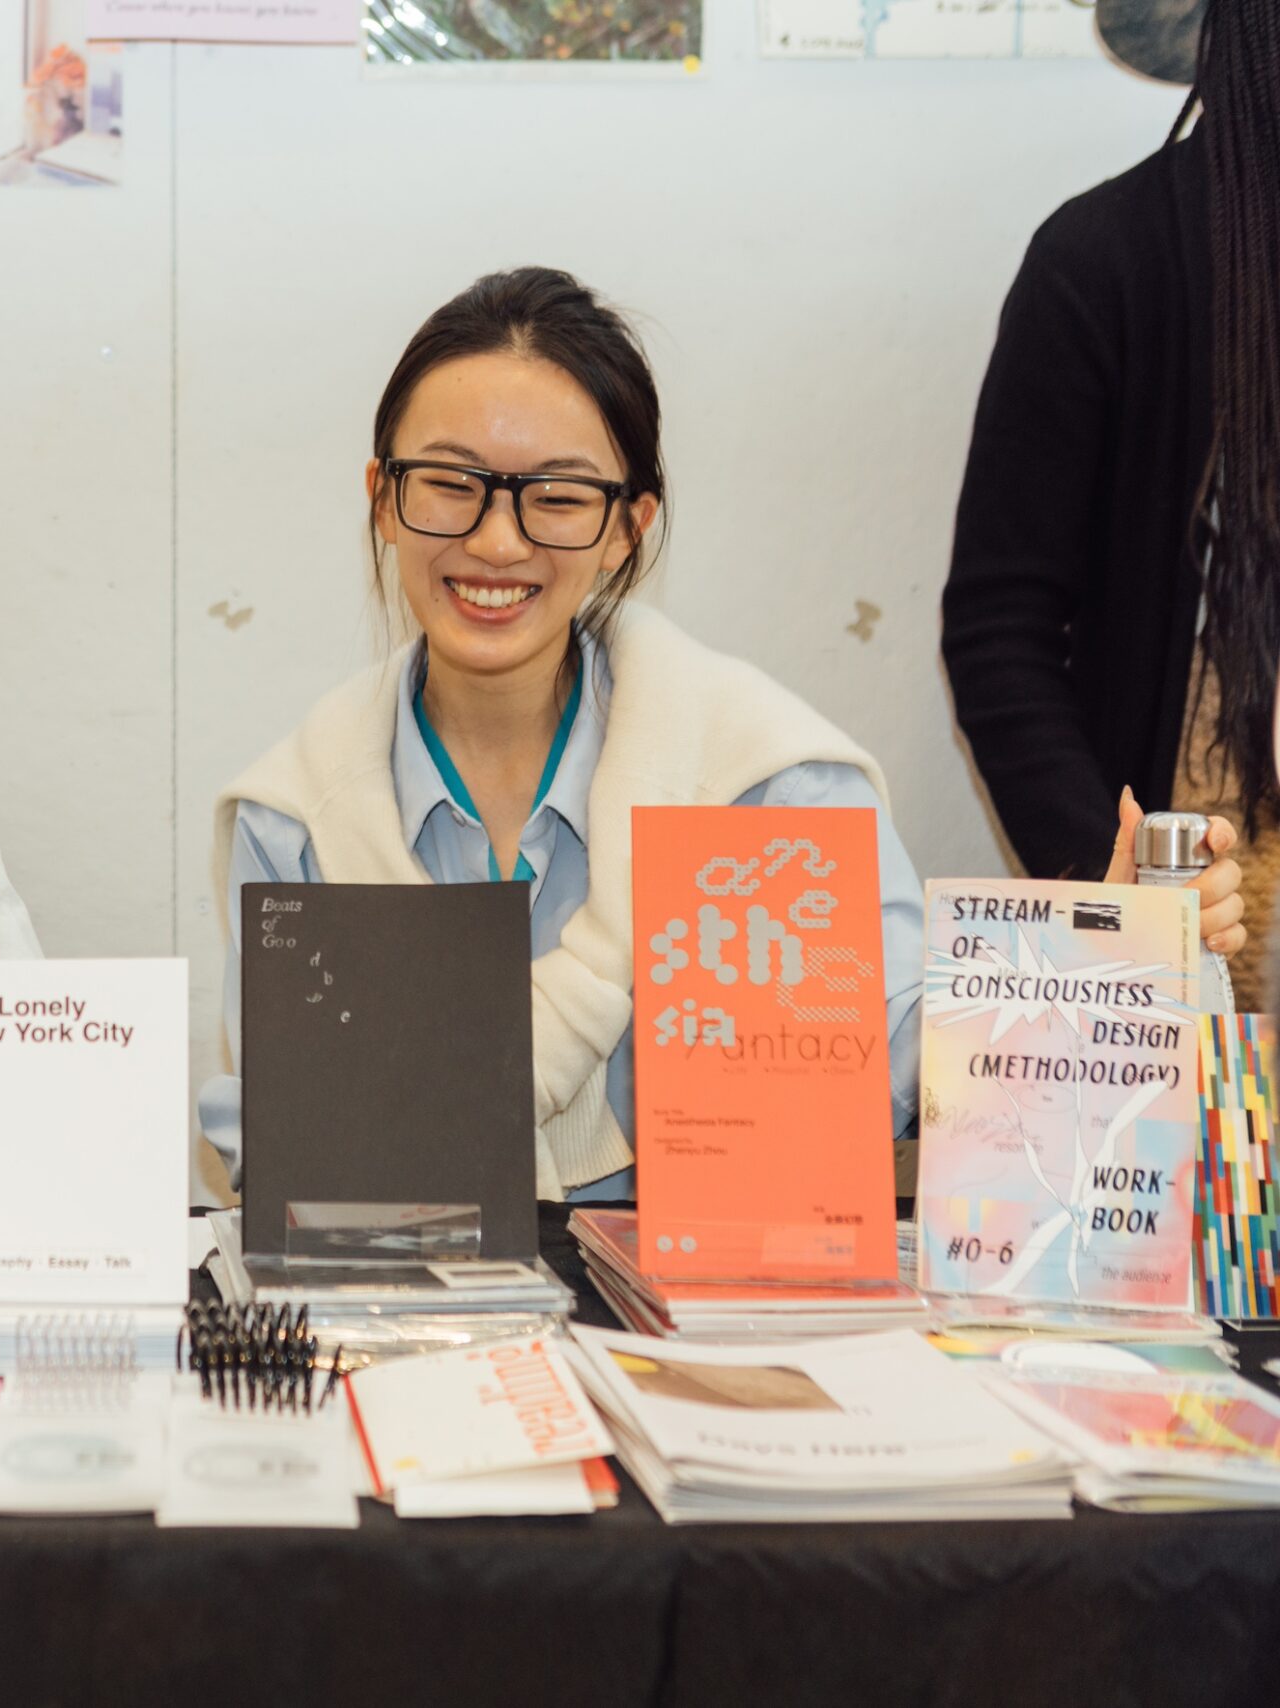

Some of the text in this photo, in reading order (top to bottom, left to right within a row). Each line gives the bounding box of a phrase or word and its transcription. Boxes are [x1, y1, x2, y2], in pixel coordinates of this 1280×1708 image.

[262, 915, 281, 932] of
[951, 974, 1154, 1007] CONSCIOUSNESS
[15, 1022, 73, 1043] York
[83, 1022, 135, 1047] City
[1093, 1021, 1180, 1050] DESIGN
[1093, 1166, 1176, 1196] WORK-
[1092, 1207, 1159, 1236] BOOK
[48, 1256, 89, 1270] Essay
[105, 1256, 132, 1268] Talk
